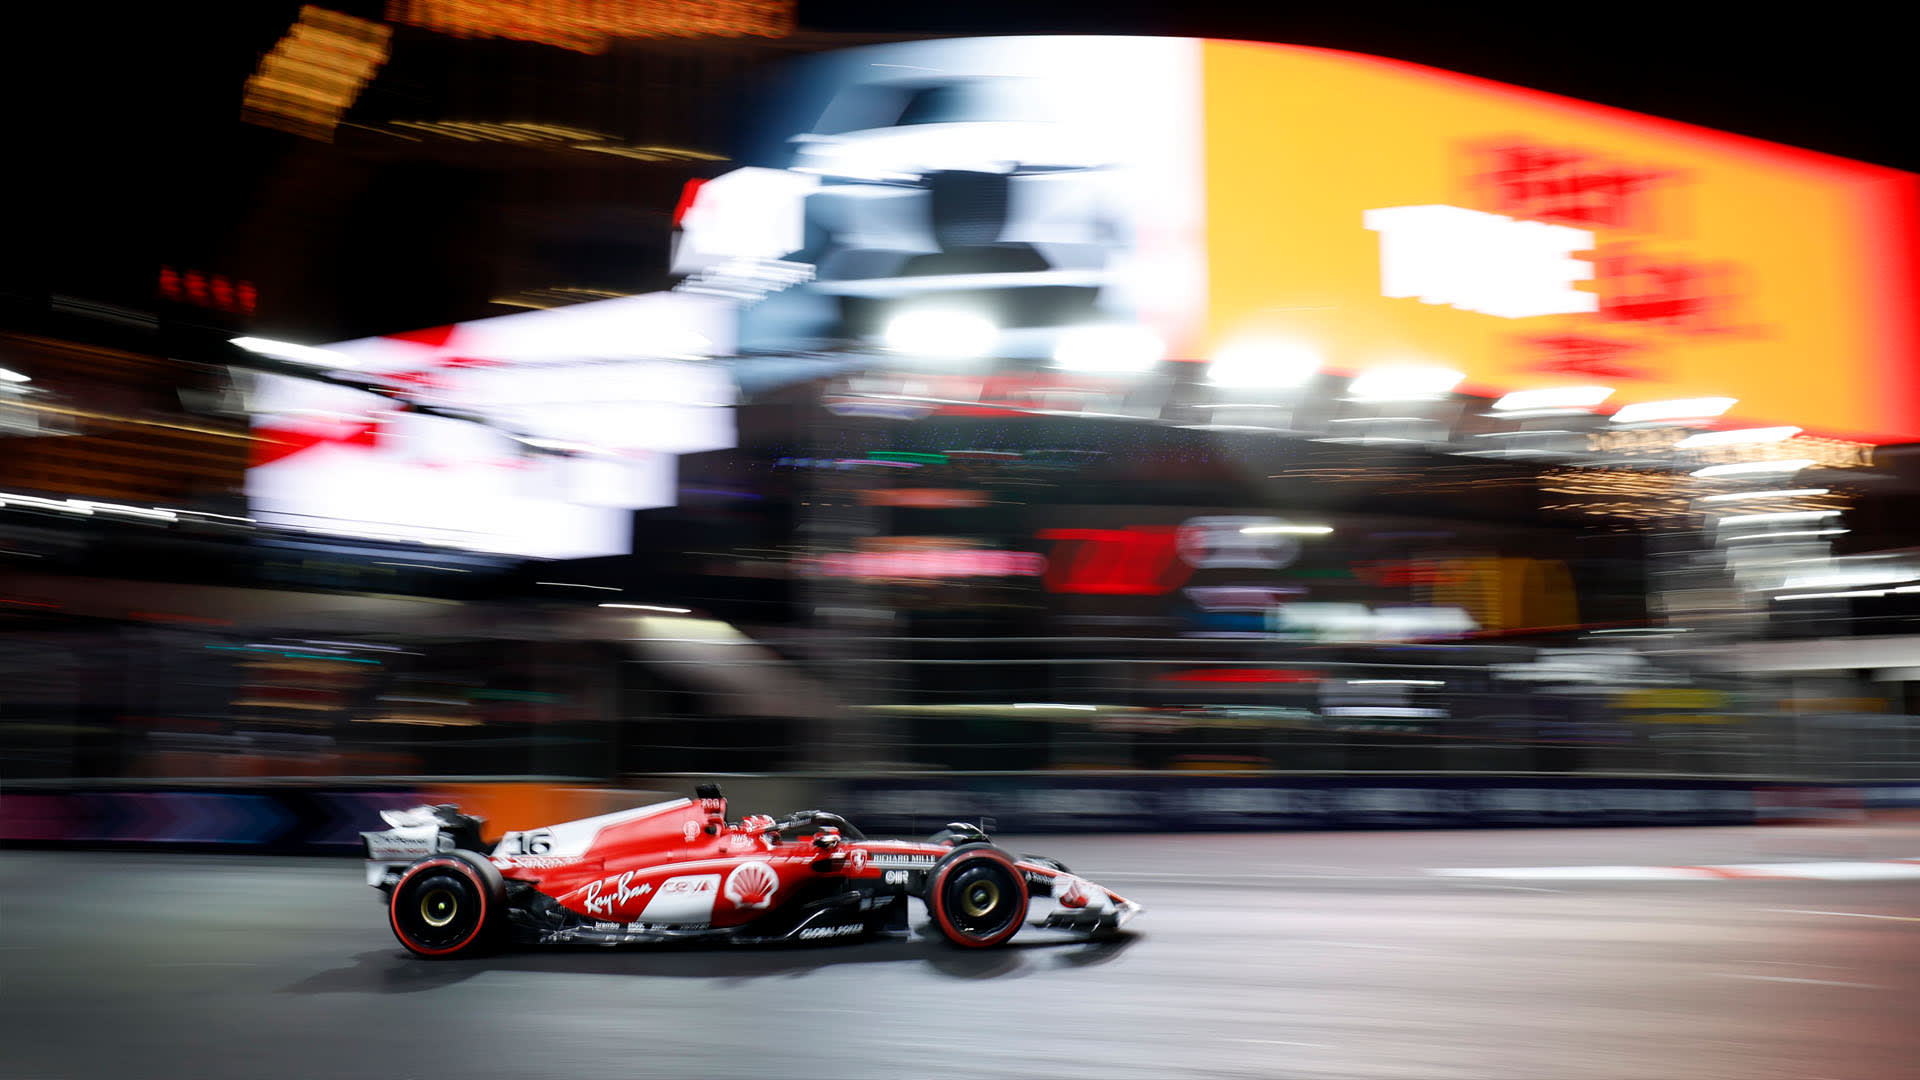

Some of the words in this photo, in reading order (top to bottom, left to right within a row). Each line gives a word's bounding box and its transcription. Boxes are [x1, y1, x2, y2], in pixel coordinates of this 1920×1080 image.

[509, 832, 551, 856] 16
[873, 854, 909, 863] RICHARD
[911, 854, 936, 863] MILLE
[578, 870, 653, 915] Ray-Ban
[595, 921, 620, 930] brembo
